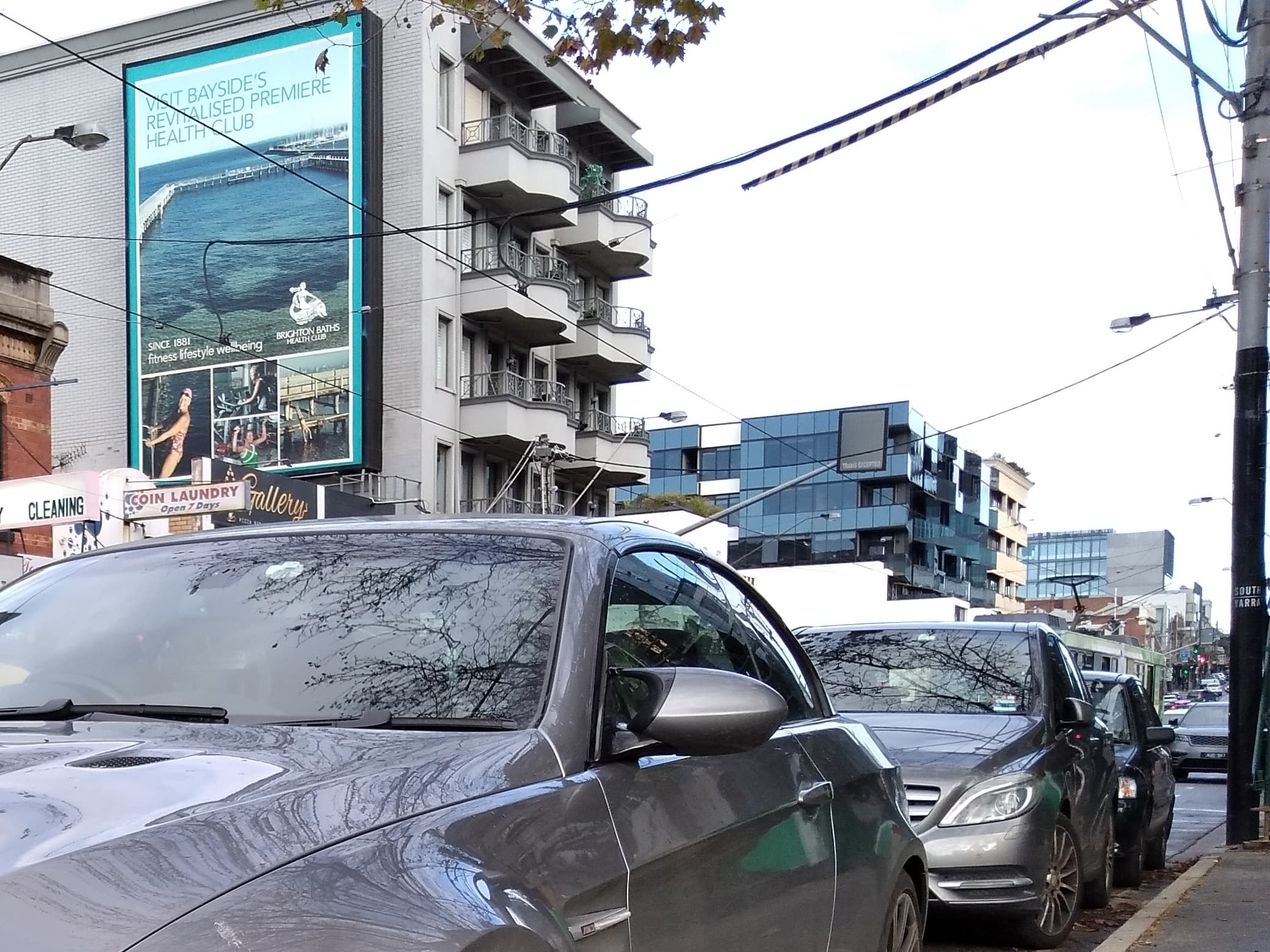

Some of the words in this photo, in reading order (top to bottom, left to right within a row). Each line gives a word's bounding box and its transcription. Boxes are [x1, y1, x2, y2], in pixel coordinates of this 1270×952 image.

[146, 90, 183, 112] VISIT
[187, 71, 267, 104] BAYSIDE'S
[146, 97, 245, 131] REVITALISED
[250, 76, 332, 110] PREMIERE
[146, 126, 206, 149] HEALTH
[212, 113, 254, 136] CLUB
[276, 327, 315, 340] BRIGHTON
[316, 323, 340, 334] BATHS
[286, 335, 311, 345] HEALTH
[311, 333, 327, 343] CLUB
[148, 340, 171, 352] SINCE
[173, 338, 191, 348] 1881
[148, 351, 177, 364] fitness
[179, 346, 215, 360] lifestyle
[216, 340, 263, 356] wellbeing
[131, 492, 165, 506] COIN
[171, 485, 240, 503] LAUNDRY
[28, 496, 84, 521] CLEANING
[161, 504, 186, 514] Open
[188, 503, 194, 511] 7
[196, 501, 220, 511] Days
[1234, 586, 1262, 596] SOUTH
[1234, 598, 1261, 608] YARRA
